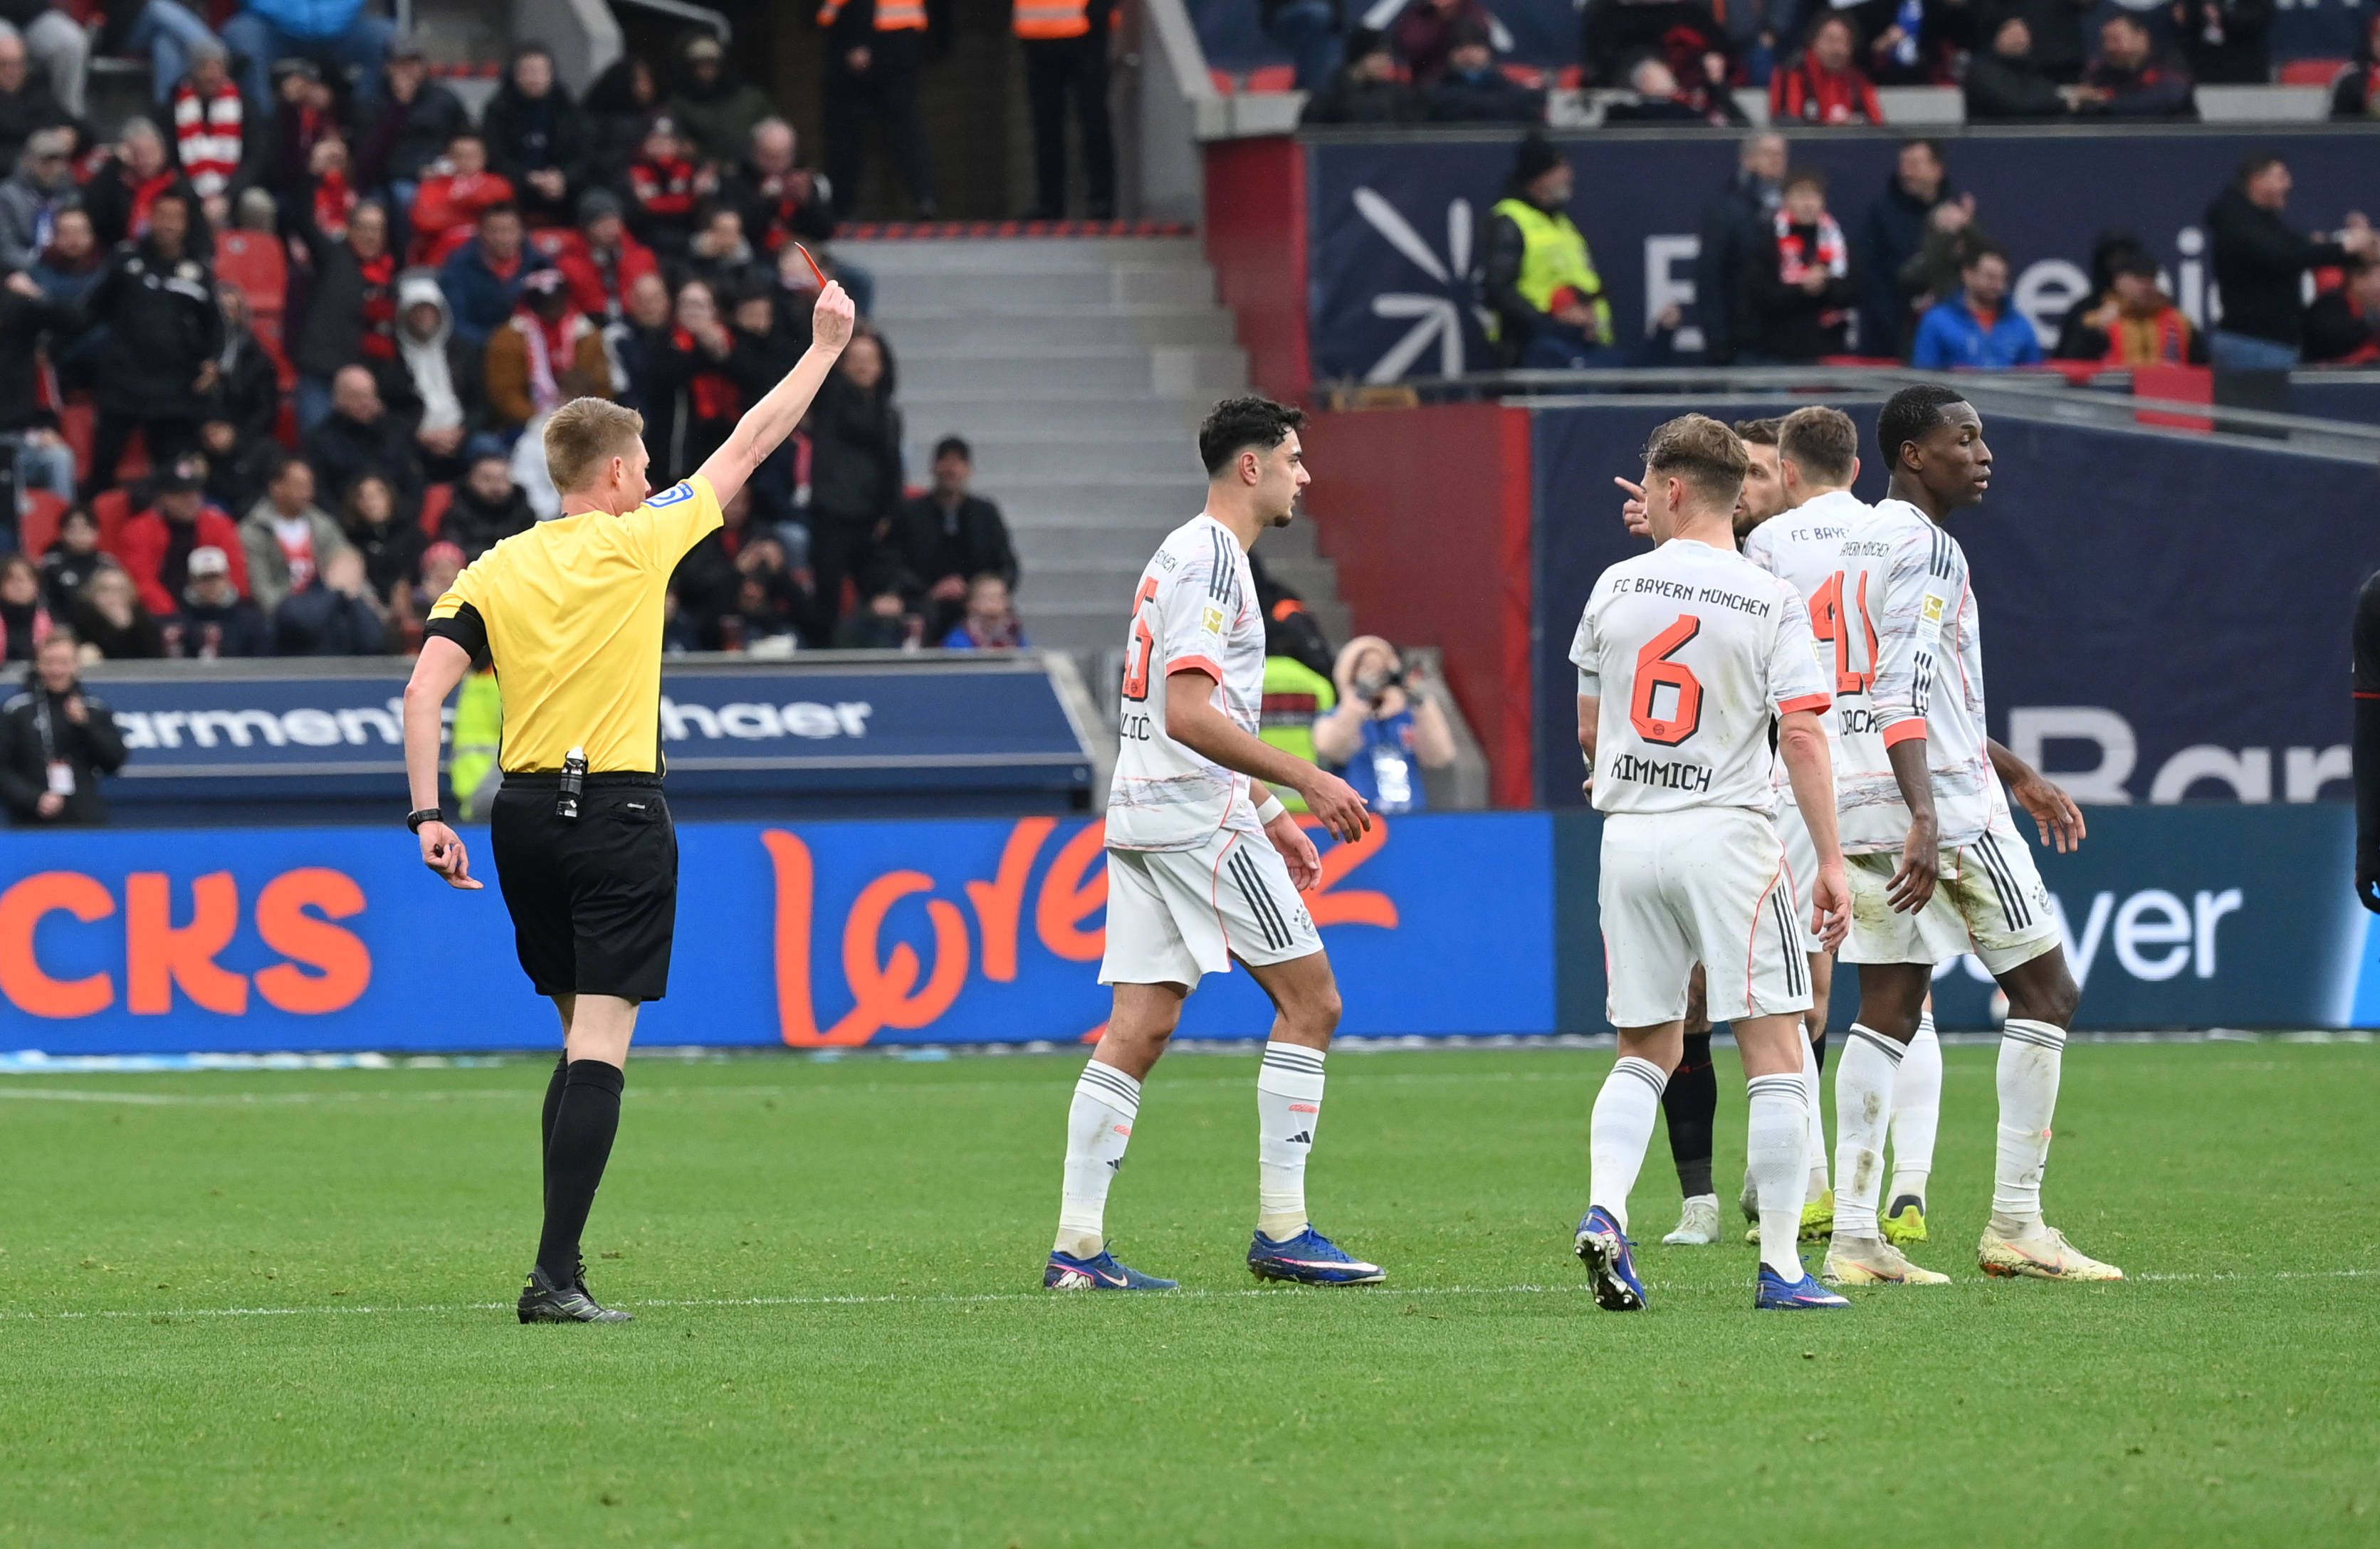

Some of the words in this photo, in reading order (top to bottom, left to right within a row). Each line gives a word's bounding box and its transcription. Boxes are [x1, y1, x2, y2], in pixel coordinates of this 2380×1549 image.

[1791, 528, 1809, 542] FC
[1813, 527, 1850, 540] BAYE
[1612, 578, 1630, 594] FC
[1635, 577, 1694, 601] BAYERN
[1698, 588, 1771, 618] MÜNCHEN
[1629, 613, 1704, 747] 6
[112, 697, 404, 748] armeni
[661, 695, 872, 740] haer
[1841, 709, 1878, 736] JACK
[1610, 752, 1714, 793] KIMMICH
